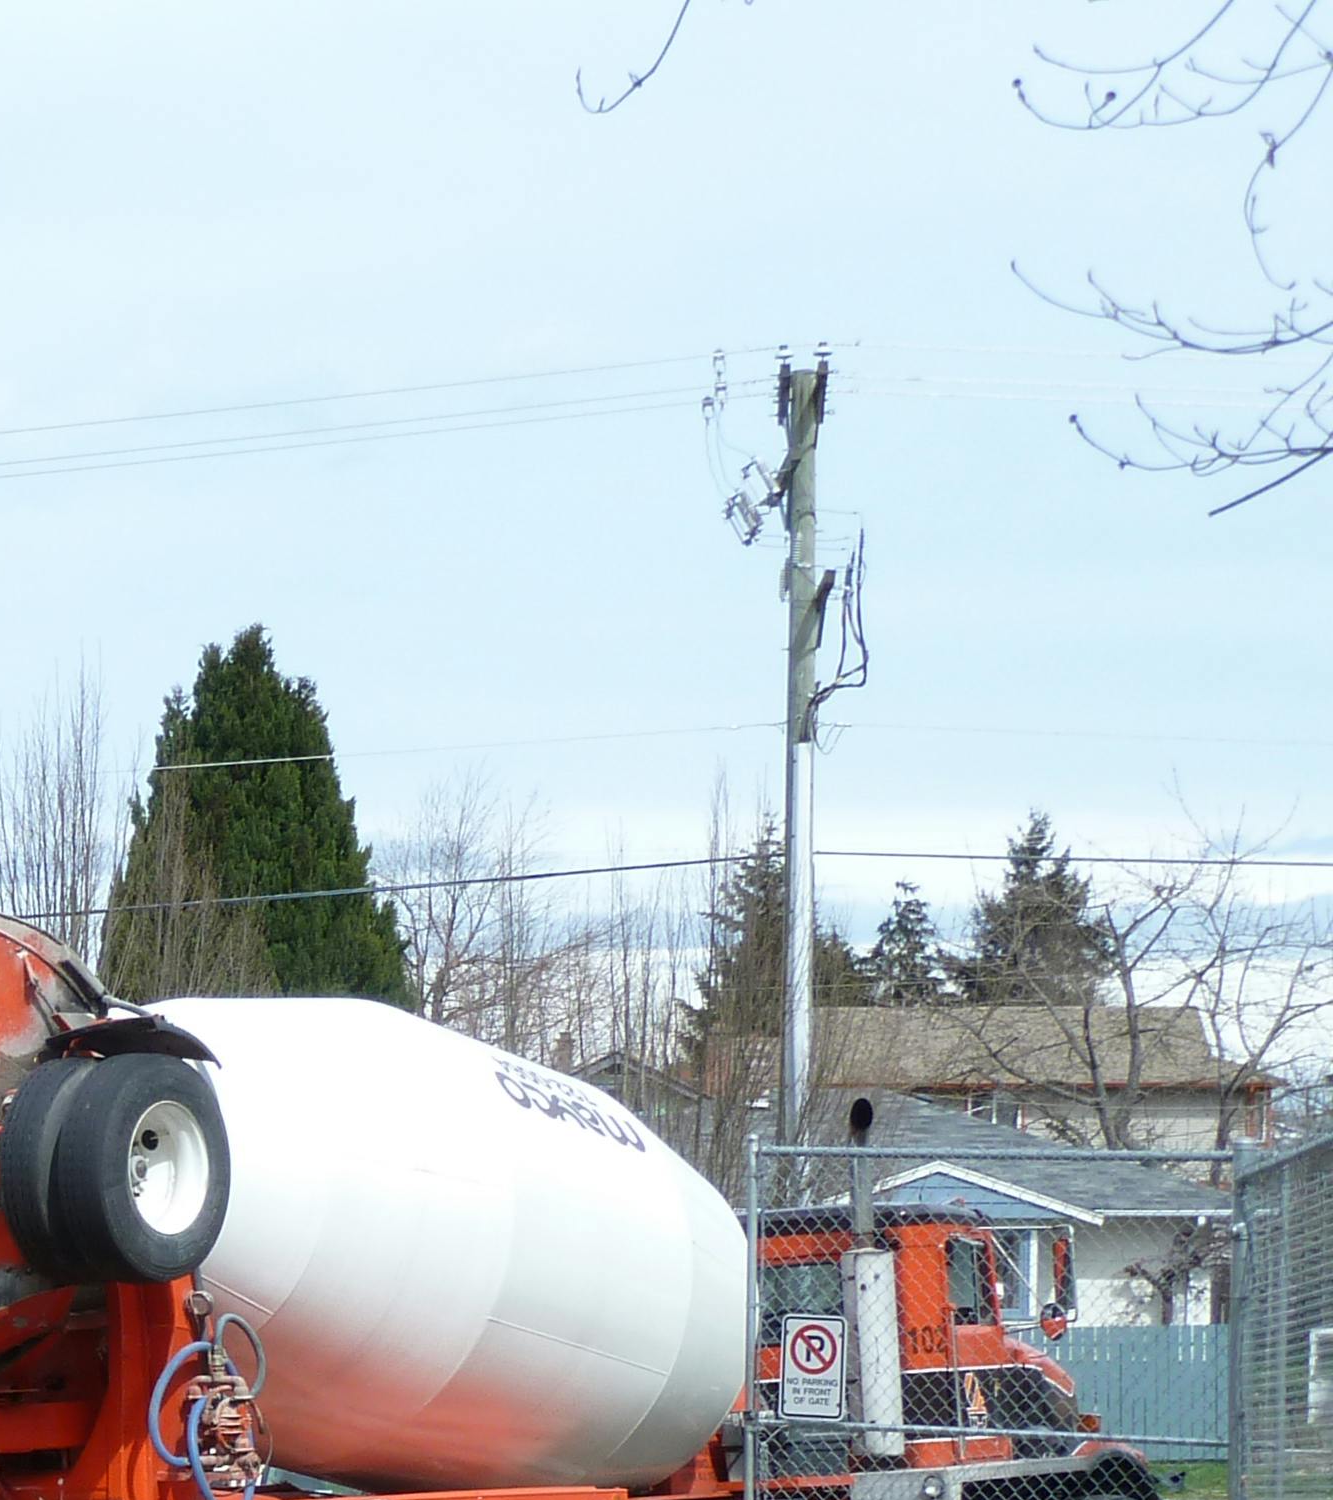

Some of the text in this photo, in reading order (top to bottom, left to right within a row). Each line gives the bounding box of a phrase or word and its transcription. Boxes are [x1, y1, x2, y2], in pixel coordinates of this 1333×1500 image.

[786, 1377, 838, 1388] NO PARKING
[792, 1387, 832, 1397] IN FRONT
[793, 1396, 830, 1407] OF GATE
